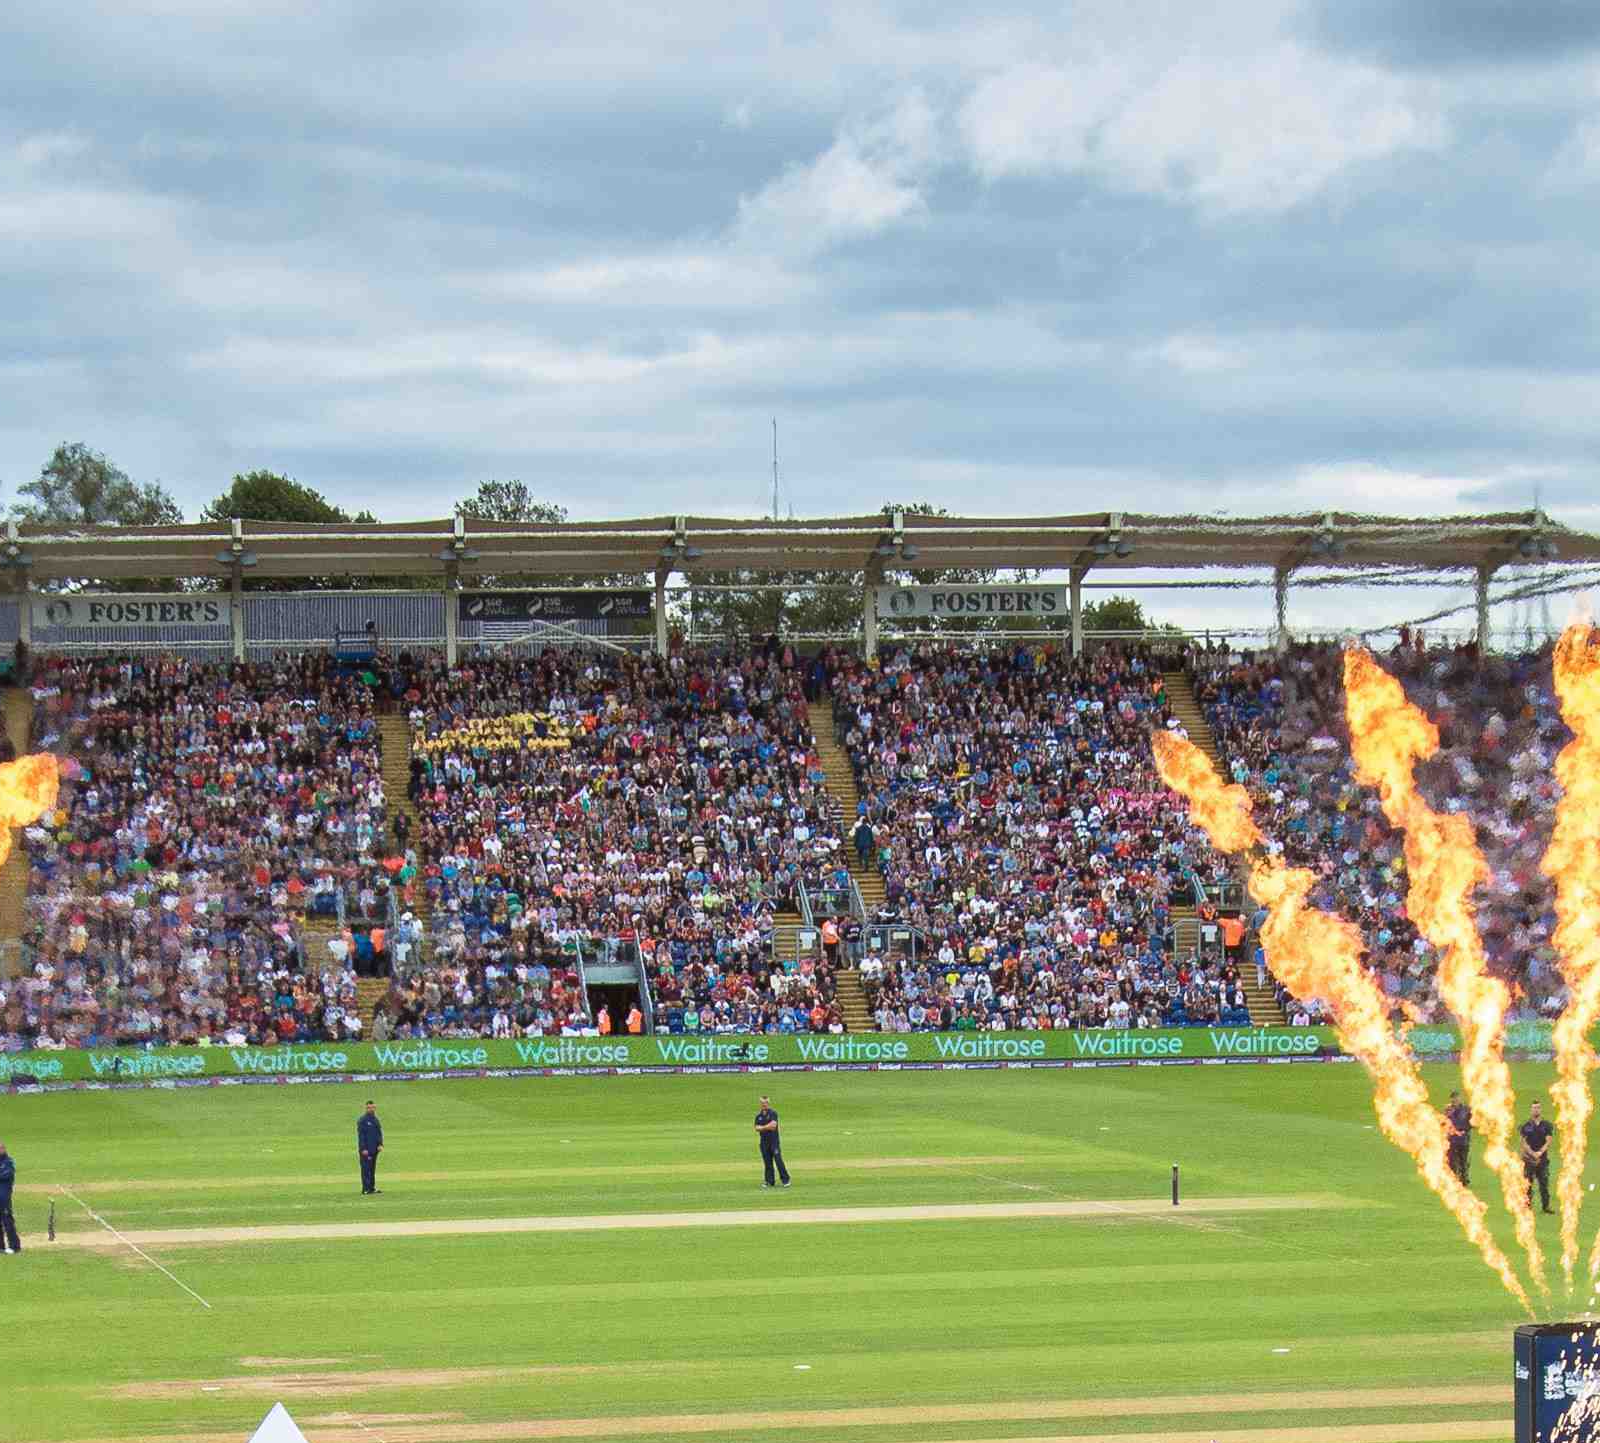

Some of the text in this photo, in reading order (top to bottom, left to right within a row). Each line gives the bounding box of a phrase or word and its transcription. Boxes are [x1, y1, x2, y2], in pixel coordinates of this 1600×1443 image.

[88, 602, 220, 623] FOSTER'S
[930, 591, 1057, 612] FOSTER'S
[514, 1039, 629, 1066] Waitrose
[796, 1033, 908, 1060] Waitrose
[934, 1032, 1046, 1057] Waitrose
[1072, 1030, 1183, 1056] Waitrose
[1210, 1029, 1319, 1054] Waitrose
[230, 1045, 349, 1072] Waitrose
[373, 1041, 488, 1069] Waitrose
